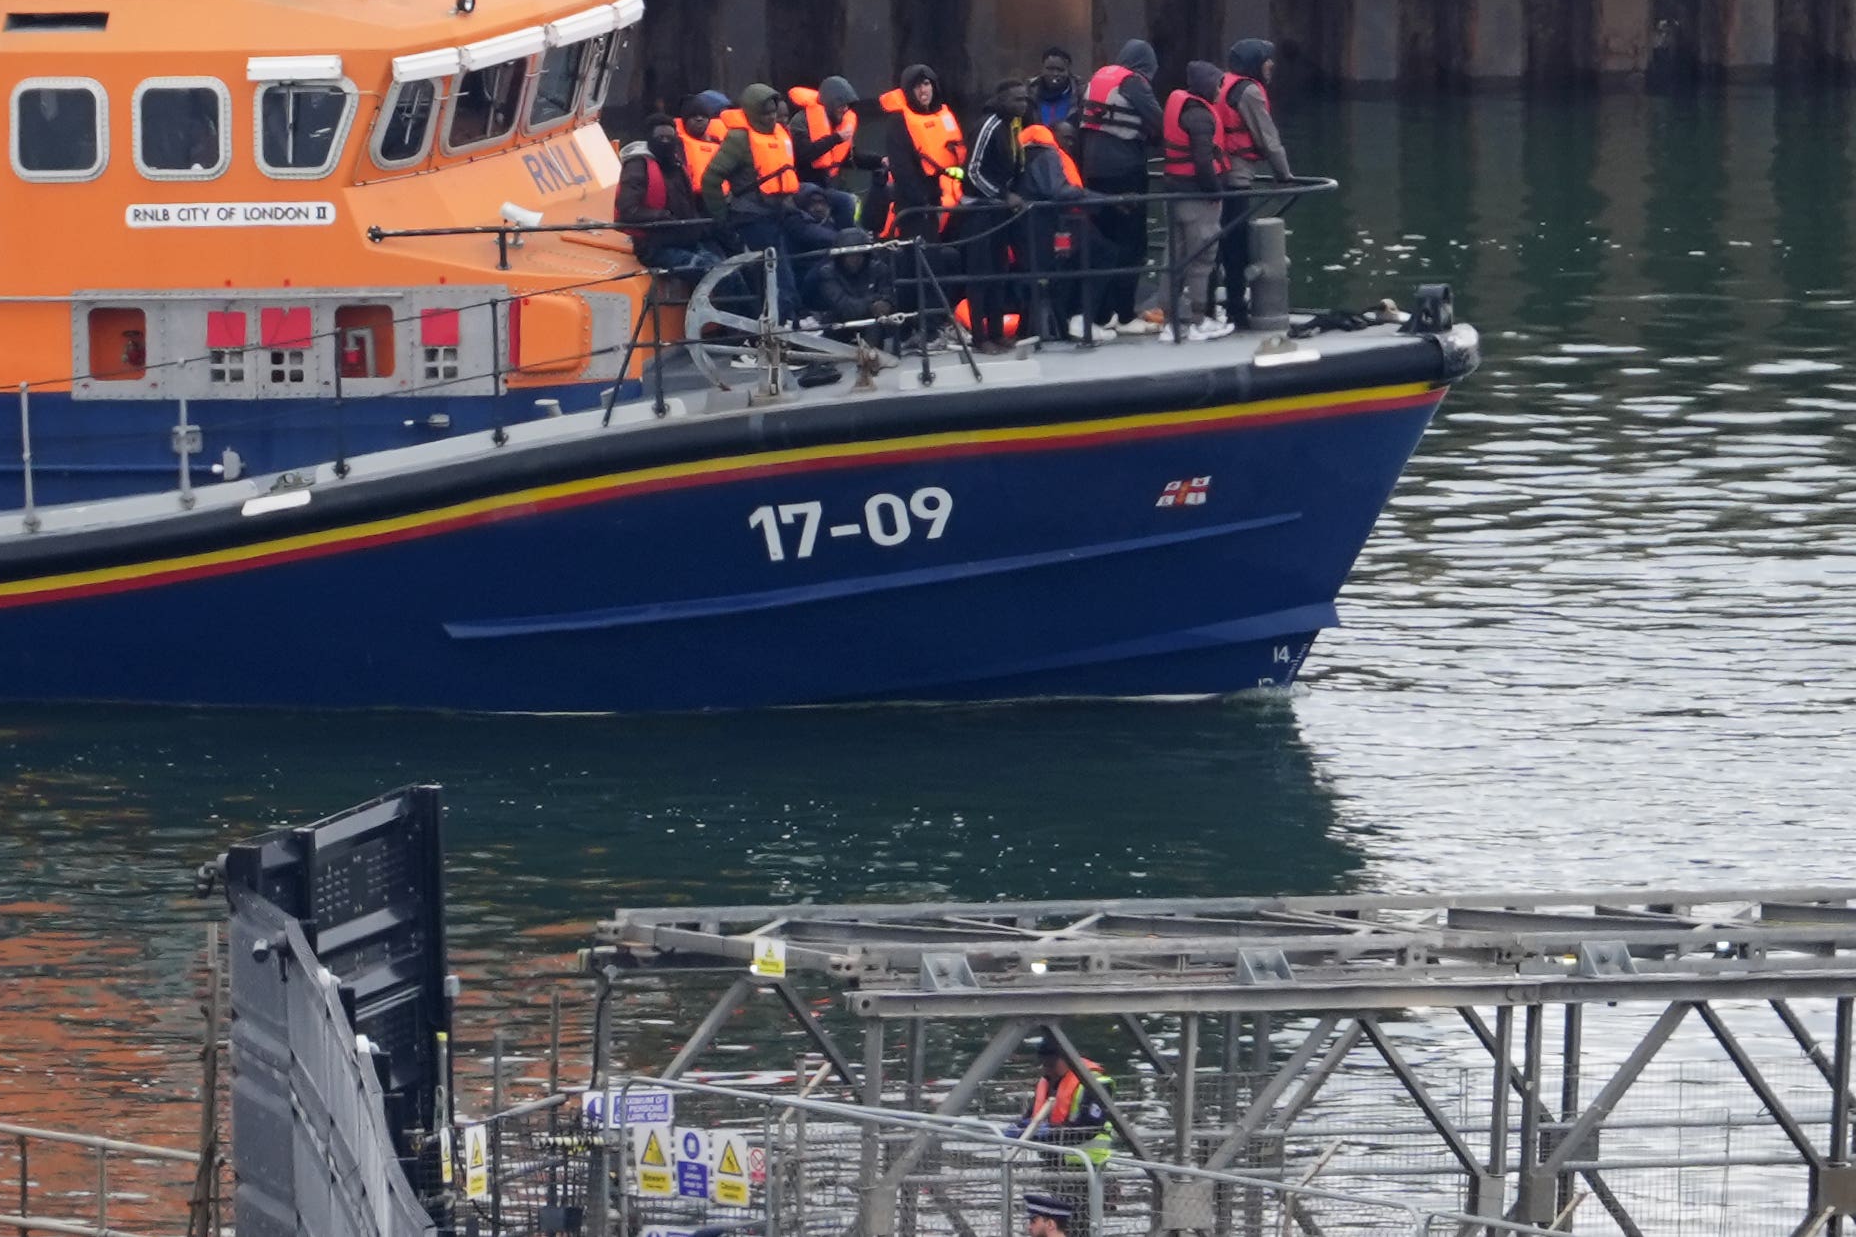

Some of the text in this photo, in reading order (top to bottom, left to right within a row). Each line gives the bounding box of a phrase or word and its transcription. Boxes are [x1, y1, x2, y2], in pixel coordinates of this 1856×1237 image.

[522, 139, 593, 195] RNLI
[133, 208, 170, 221] RNLB
[177, 208, 210, 221] CITY
[217, 207, 236, 220] OF
[244, 206, 309, 221] LONDON
[749, 487, 953, 561] 17-09
[1273, 645, 1290, 663] 14
